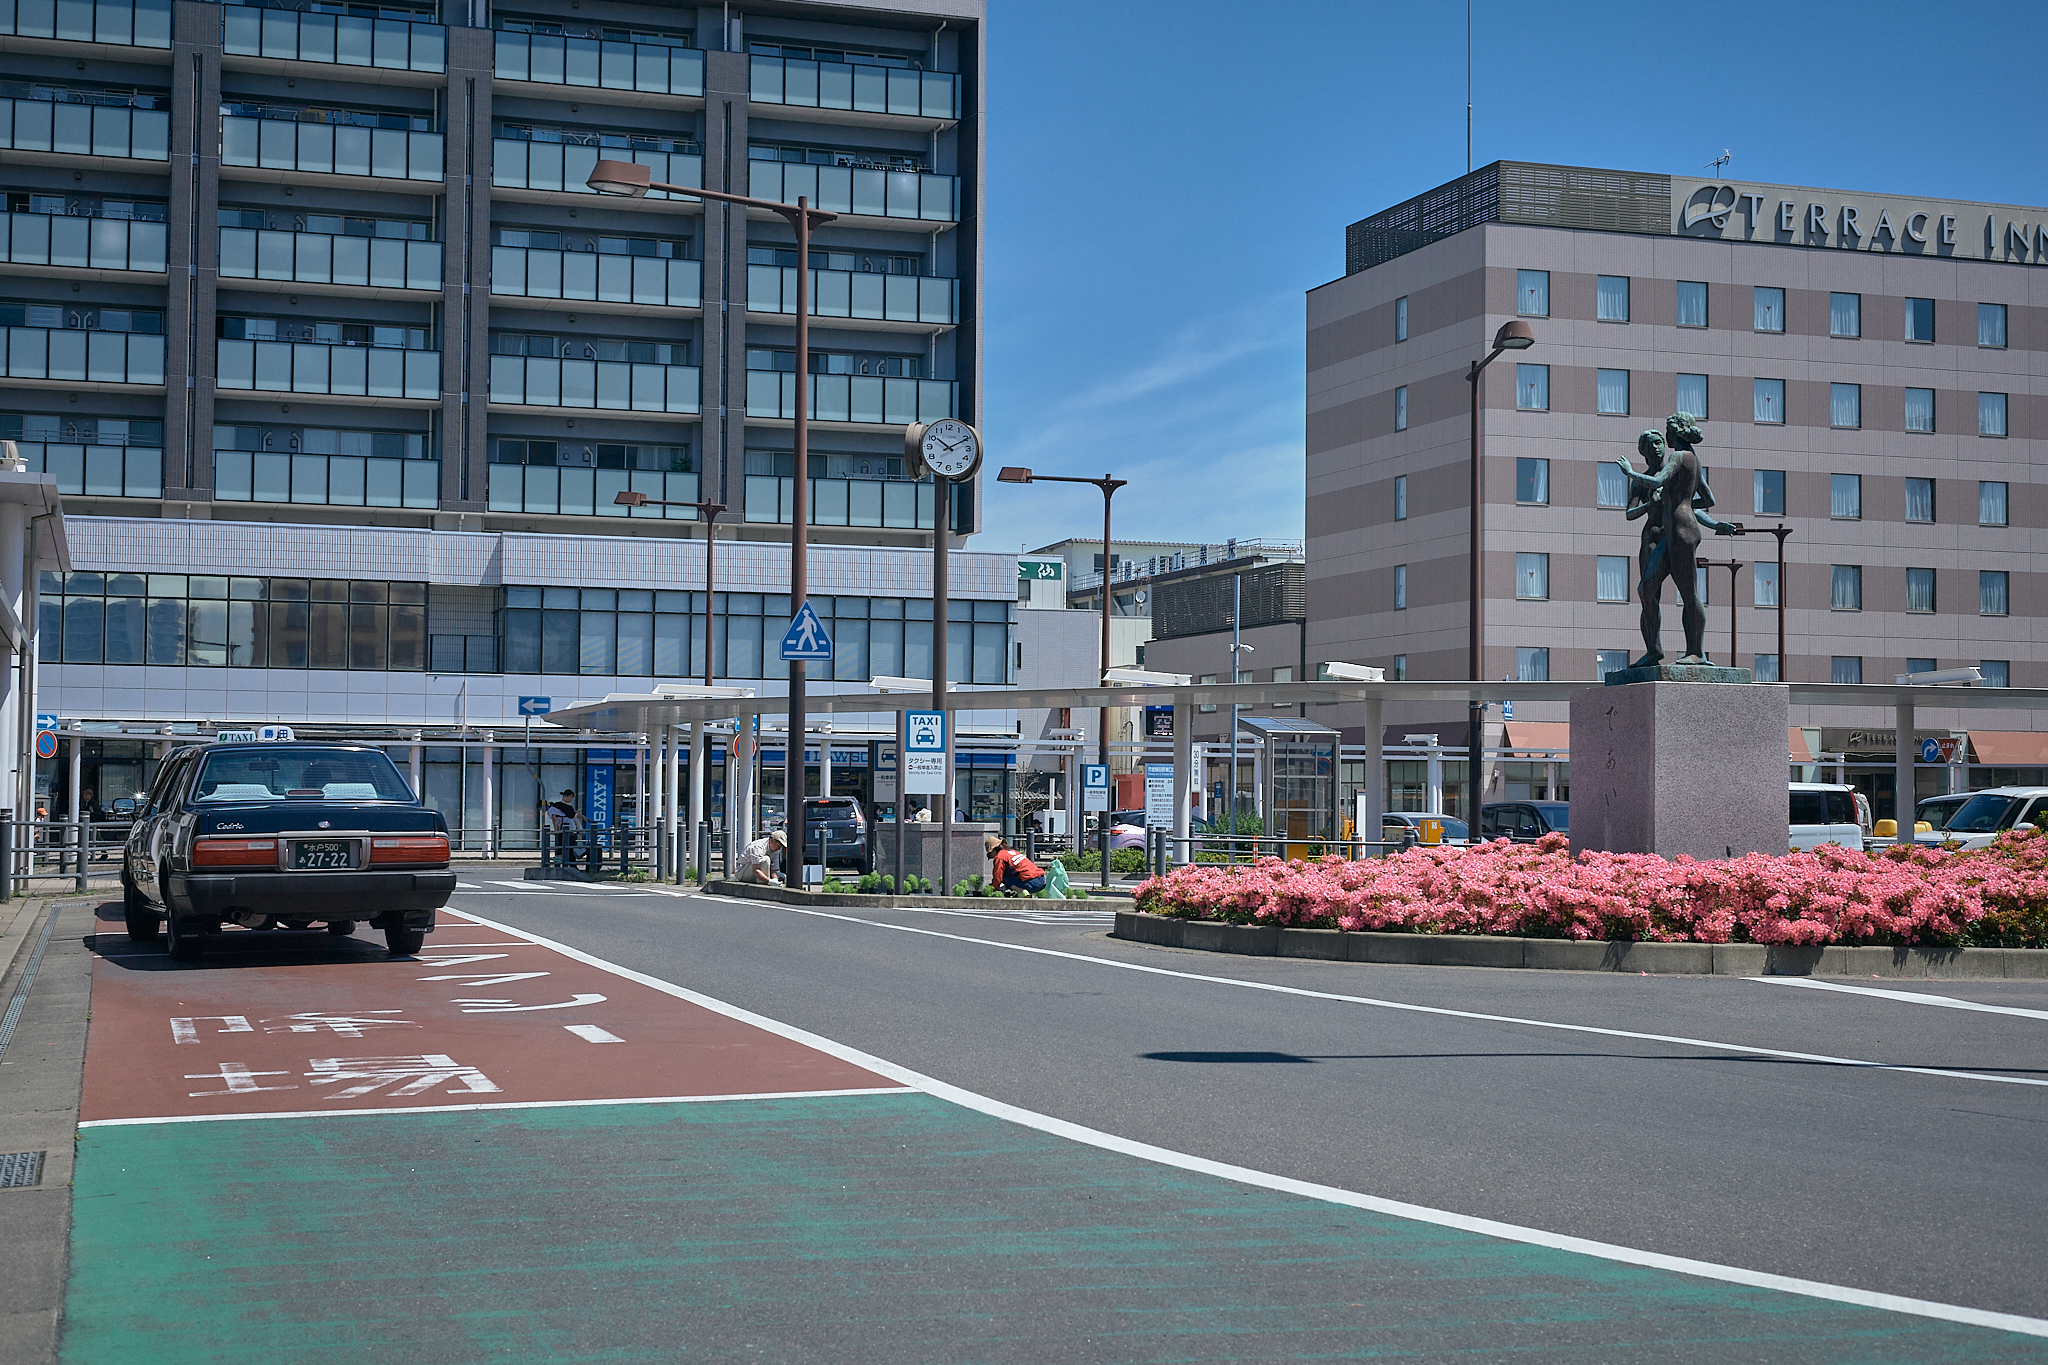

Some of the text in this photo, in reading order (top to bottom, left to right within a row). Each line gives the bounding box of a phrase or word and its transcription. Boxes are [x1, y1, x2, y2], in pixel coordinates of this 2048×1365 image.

[1742, 193, 1957, 244] TERRACE
[912, 717, 938, 726] TAXI
[1865, 733, 1897, 741] TERRA
[1092, 770, 1102, 782] P
[308, 853, 347, 866] 27-22
